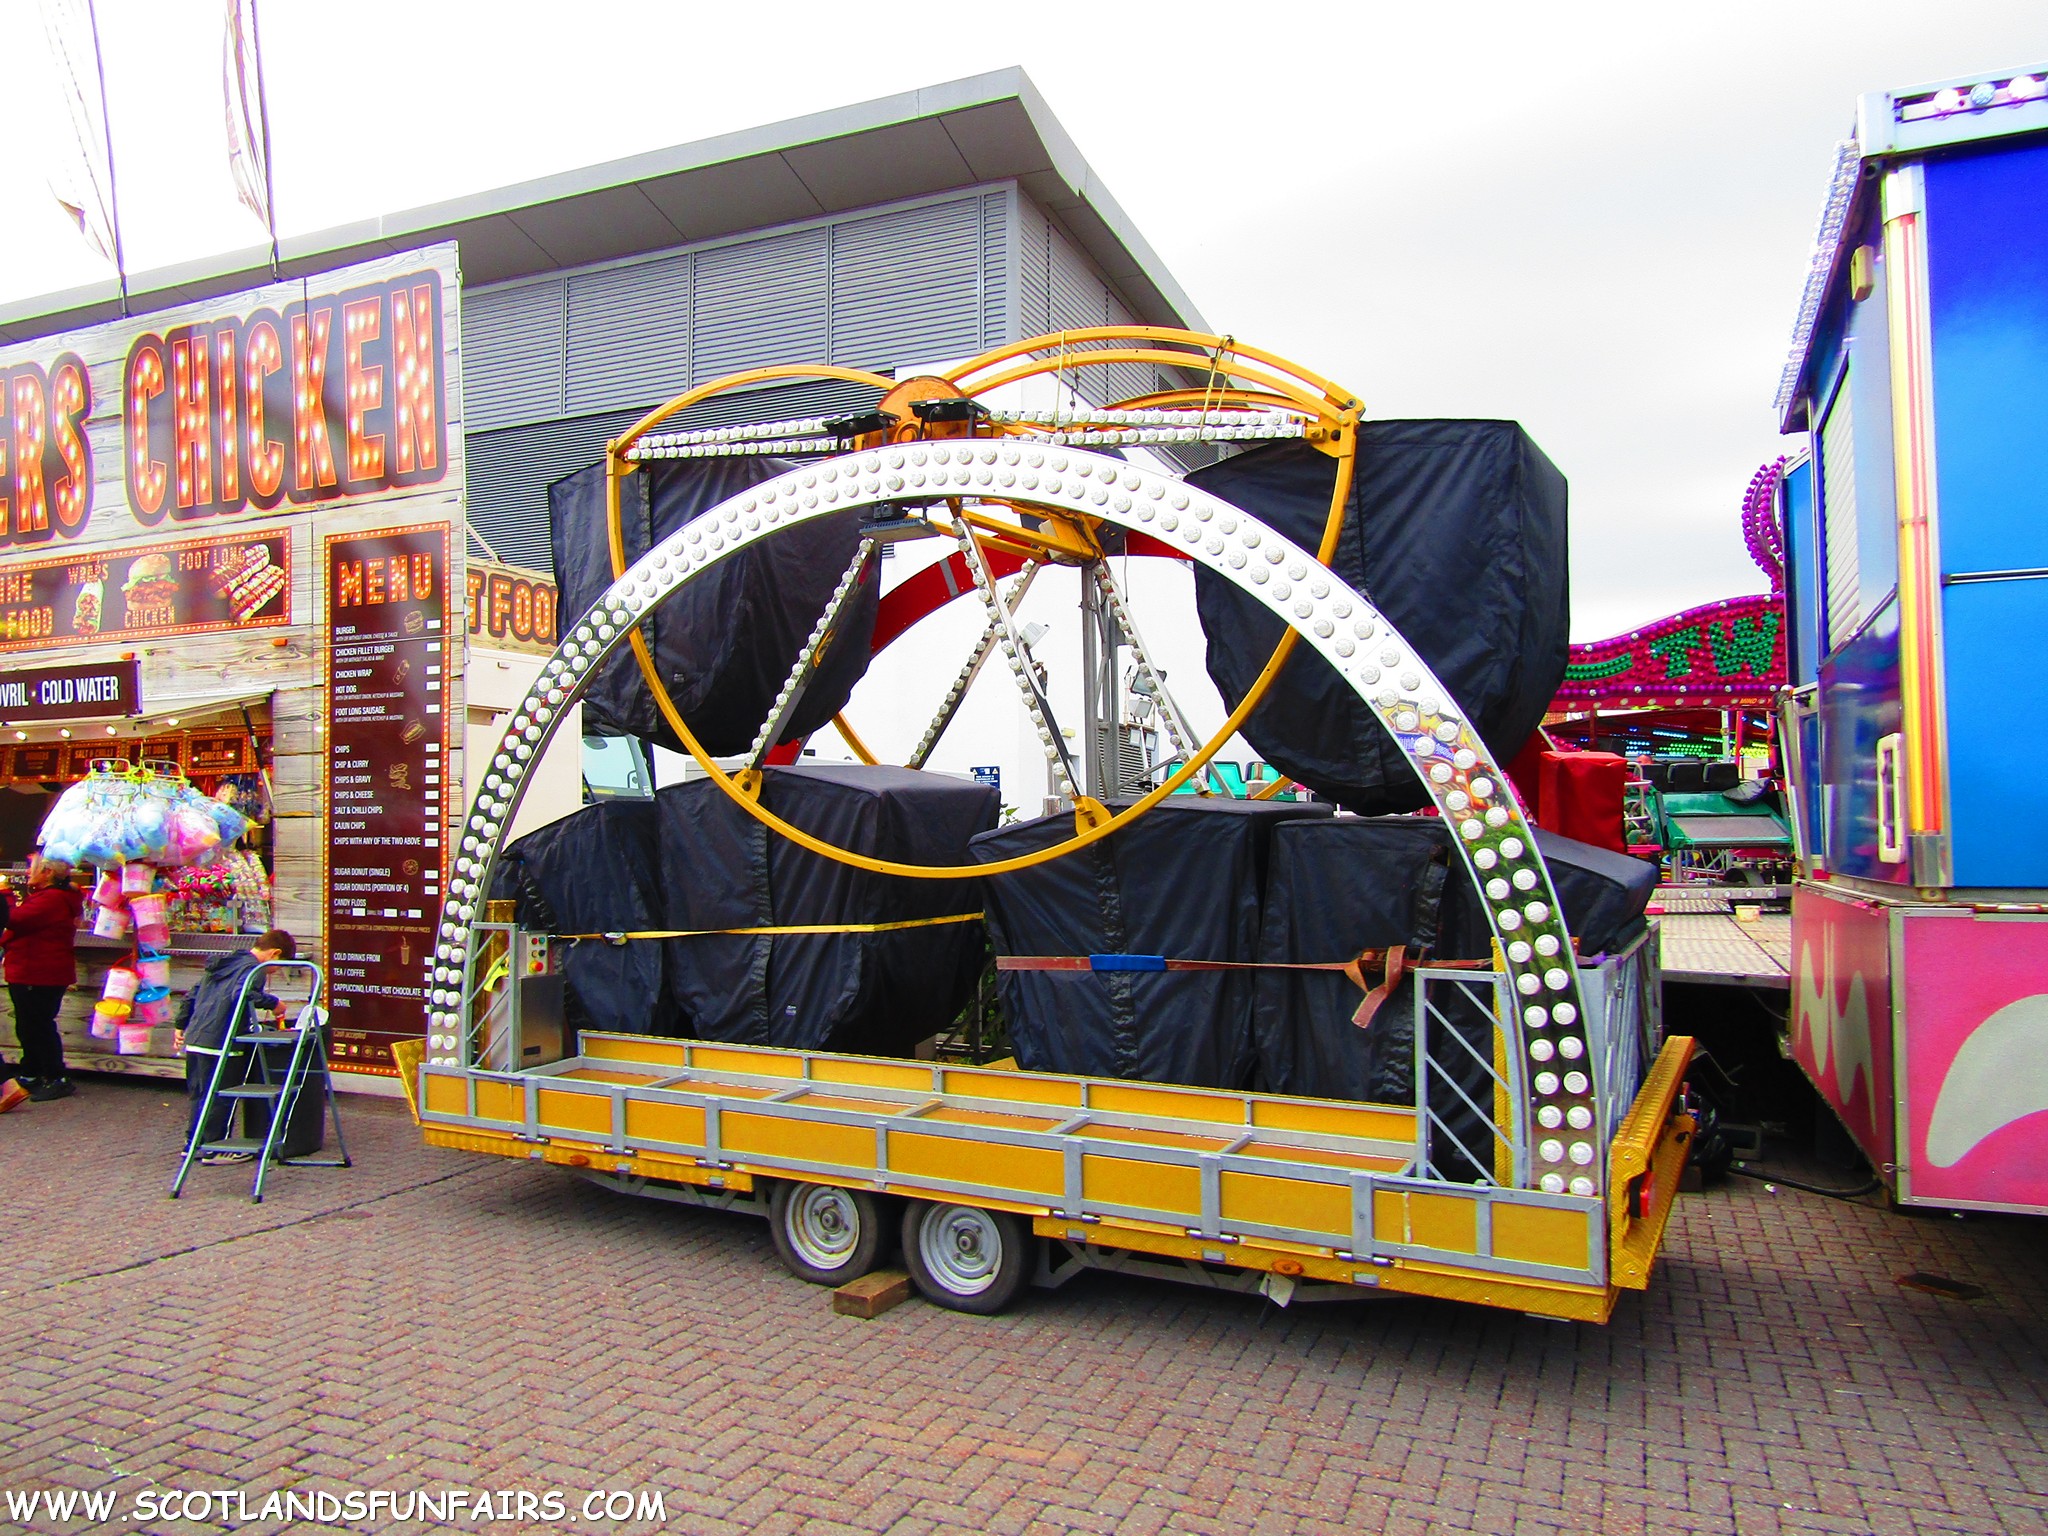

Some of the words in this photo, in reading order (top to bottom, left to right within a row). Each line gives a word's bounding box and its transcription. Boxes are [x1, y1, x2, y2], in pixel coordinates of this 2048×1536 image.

[0, 363, 87, 535] RS
[131, 284, 438, 515] CHICKEN
[178, 550, 210, 572] FOOT
[213, 546, 246, 567] LONG
[66, 562, 109, 585] WRAPS
[338, 552, 432, 608] MENU
[492, 578, 558, 640] FOO
[6, 605, 54, 639] FOOD
[124, 606, 176, 629] CHICKEN
[335, 625, 356, 635] BURGER
[336, 648, 356, 656] CHICKEN
[358, 646, 373, 655] FILLET
[374, 645, 394, 653] BURGER
[336, 669, 356, 678] CHICKEN
[357, 668, 372, 677] WRAP
[42, 679, 74, 705] COLD
[76, 676, 118, 703] WATER
[346, 685, 357, 693] DOG
[335, 708, 347, 716] FOOT
[348, 707, 362, 715] LONG
[362, 706, 385, 715] SAUSAGE
[335, 745, 350, 754] CHIPS
[335, 760, 347, 768] CHIP
[352, 760, 369, 768] CURRY
[335, 776, 349, 784] CHIPS
[334, 806, 346, 814] SALT
[334, 837, 349, 845] CHIPS
[350, 837, 363, 845] WITH
[369, 868, 390, 877] (SINGLE)
[372, 884, 395, 892] (PORTION
[403, 884, 409, 893] 4)
[348, 953, 366, 961] DRINKS
[366, 954, 381, 962] FROM
[334, 968, 343, 976] TEA
[347, 969, 365, 977] COFFEE
[366, 985, 381, 994] LATTE,
[382, 986, 391, 994] HOT
[392, 986, 421, 996] CHOCOLATE
[334, 999, 350, 1007] BOVRIL
